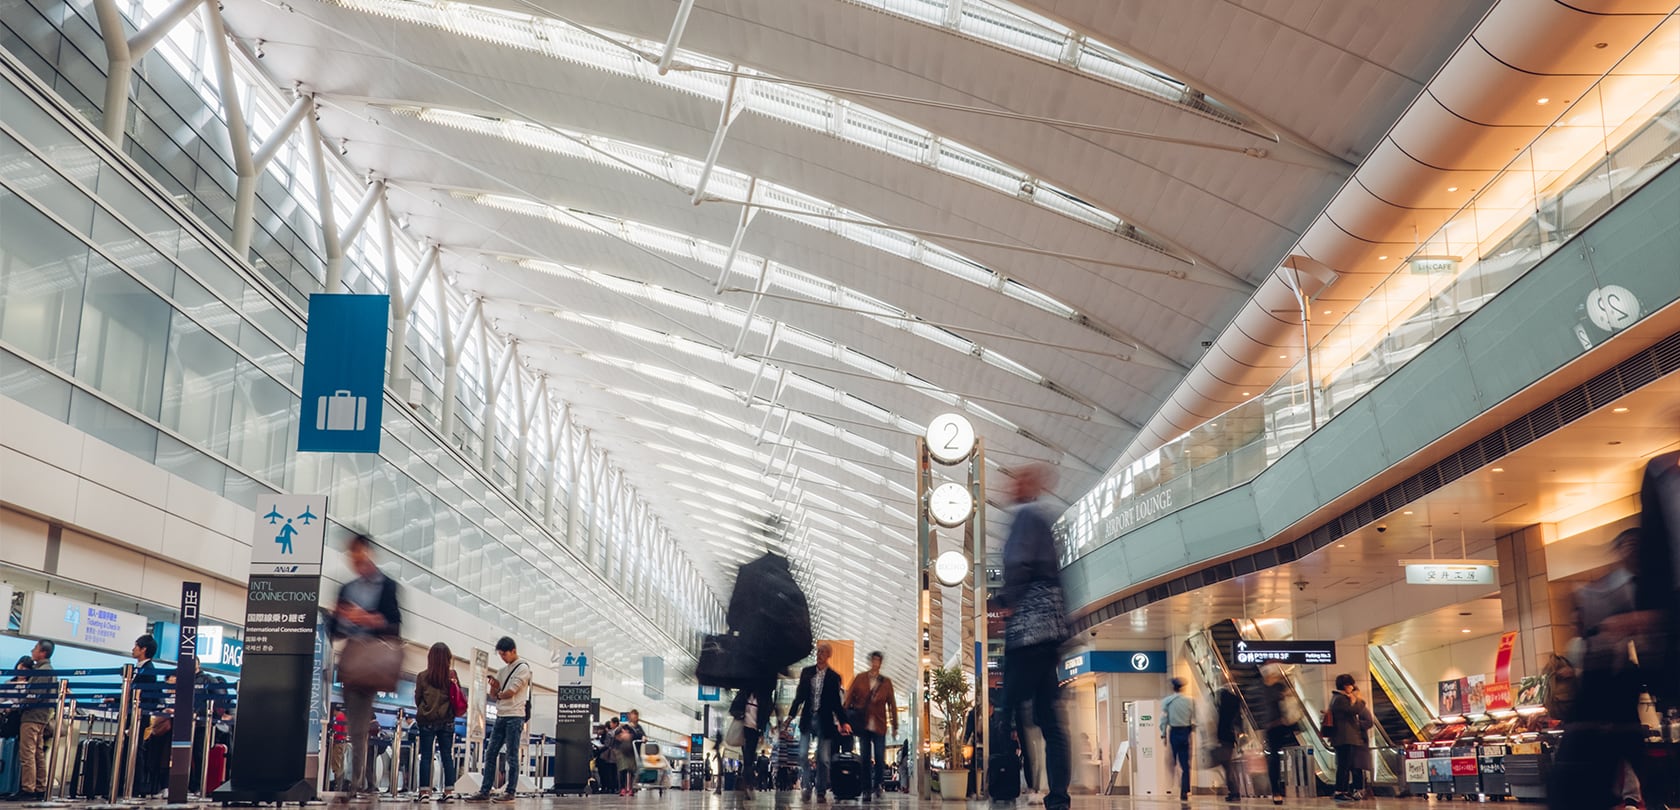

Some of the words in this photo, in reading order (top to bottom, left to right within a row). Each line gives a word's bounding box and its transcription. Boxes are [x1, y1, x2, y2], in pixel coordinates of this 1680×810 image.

[1432, 263, 1452, 271] CAFE
[943, 422, 960, 450] 2
[1105, 506, 1134, 539] AIRPORT
[1135, 488, 1173, 522] LOUNGE
[249, 591, 317, 602] CONNECTIONS
[250, 581, 273, 591] INT'L
[183, 590, 198, 619] 出口
[181, 625, 197, 660] EXIT
[222, 643, 243, 668] BAG
[309, 660, 322, 726] ENTRANCE
